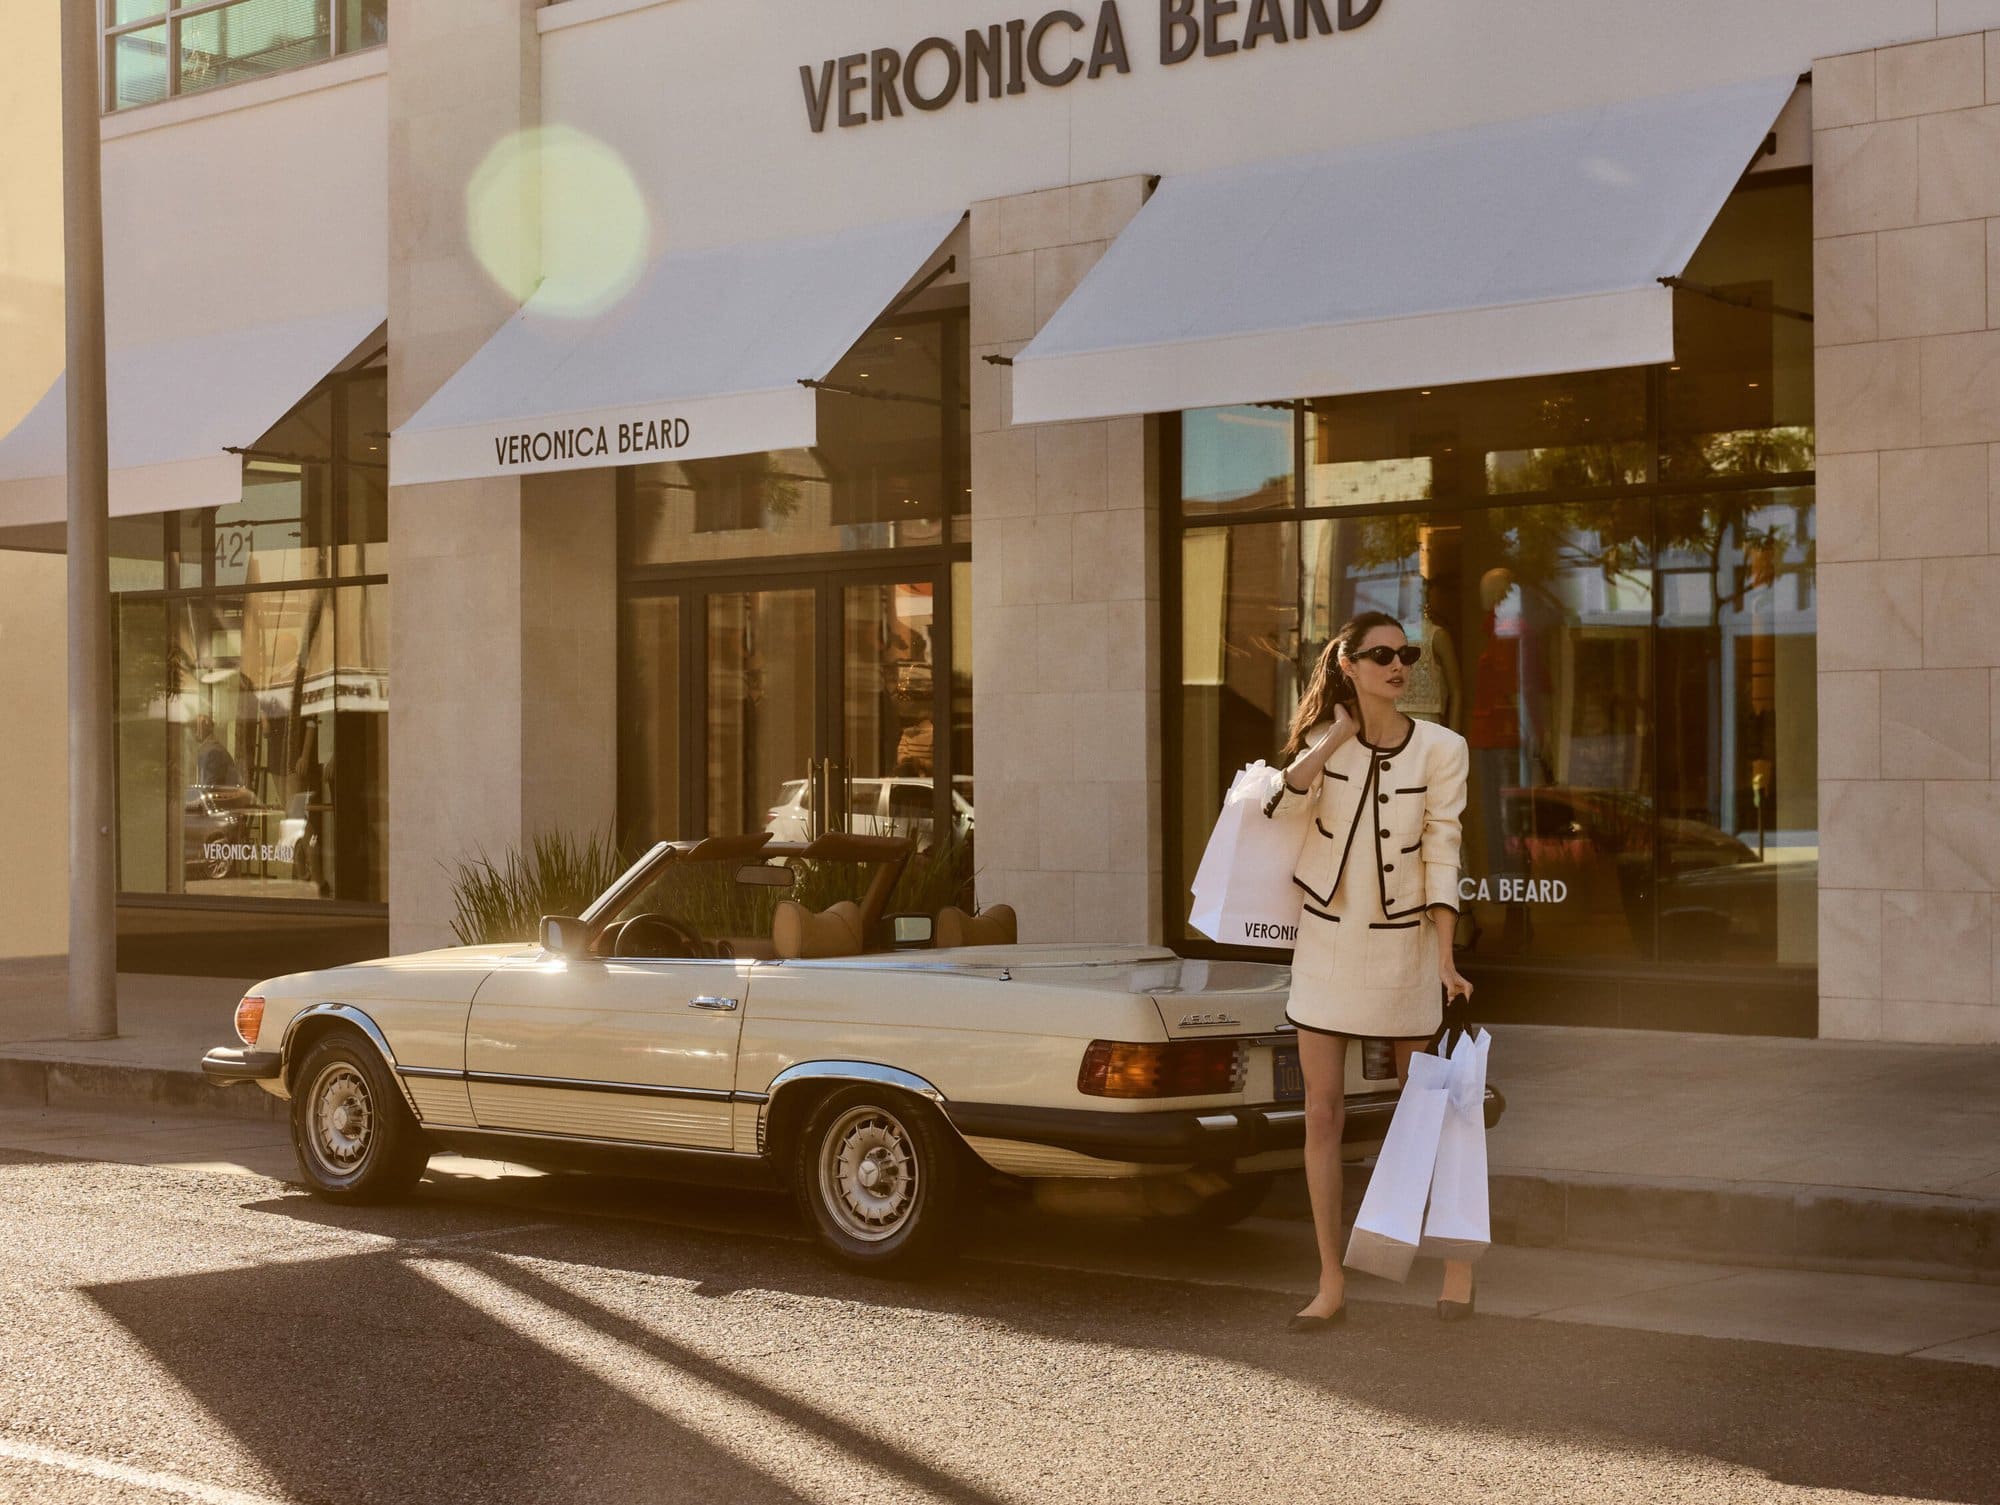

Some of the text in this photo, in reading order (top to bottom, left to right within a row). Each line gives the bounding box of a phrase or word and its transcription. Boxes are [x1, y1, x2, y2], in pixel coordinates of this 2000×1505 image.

[799, 0, 1131, 134] VERONICA
[495, 417, 690, 466] VERONICA BEARD
[203, 842, 295, 862] VERONICA BEARD
[1499, 878, 1568, 904] BEARD
